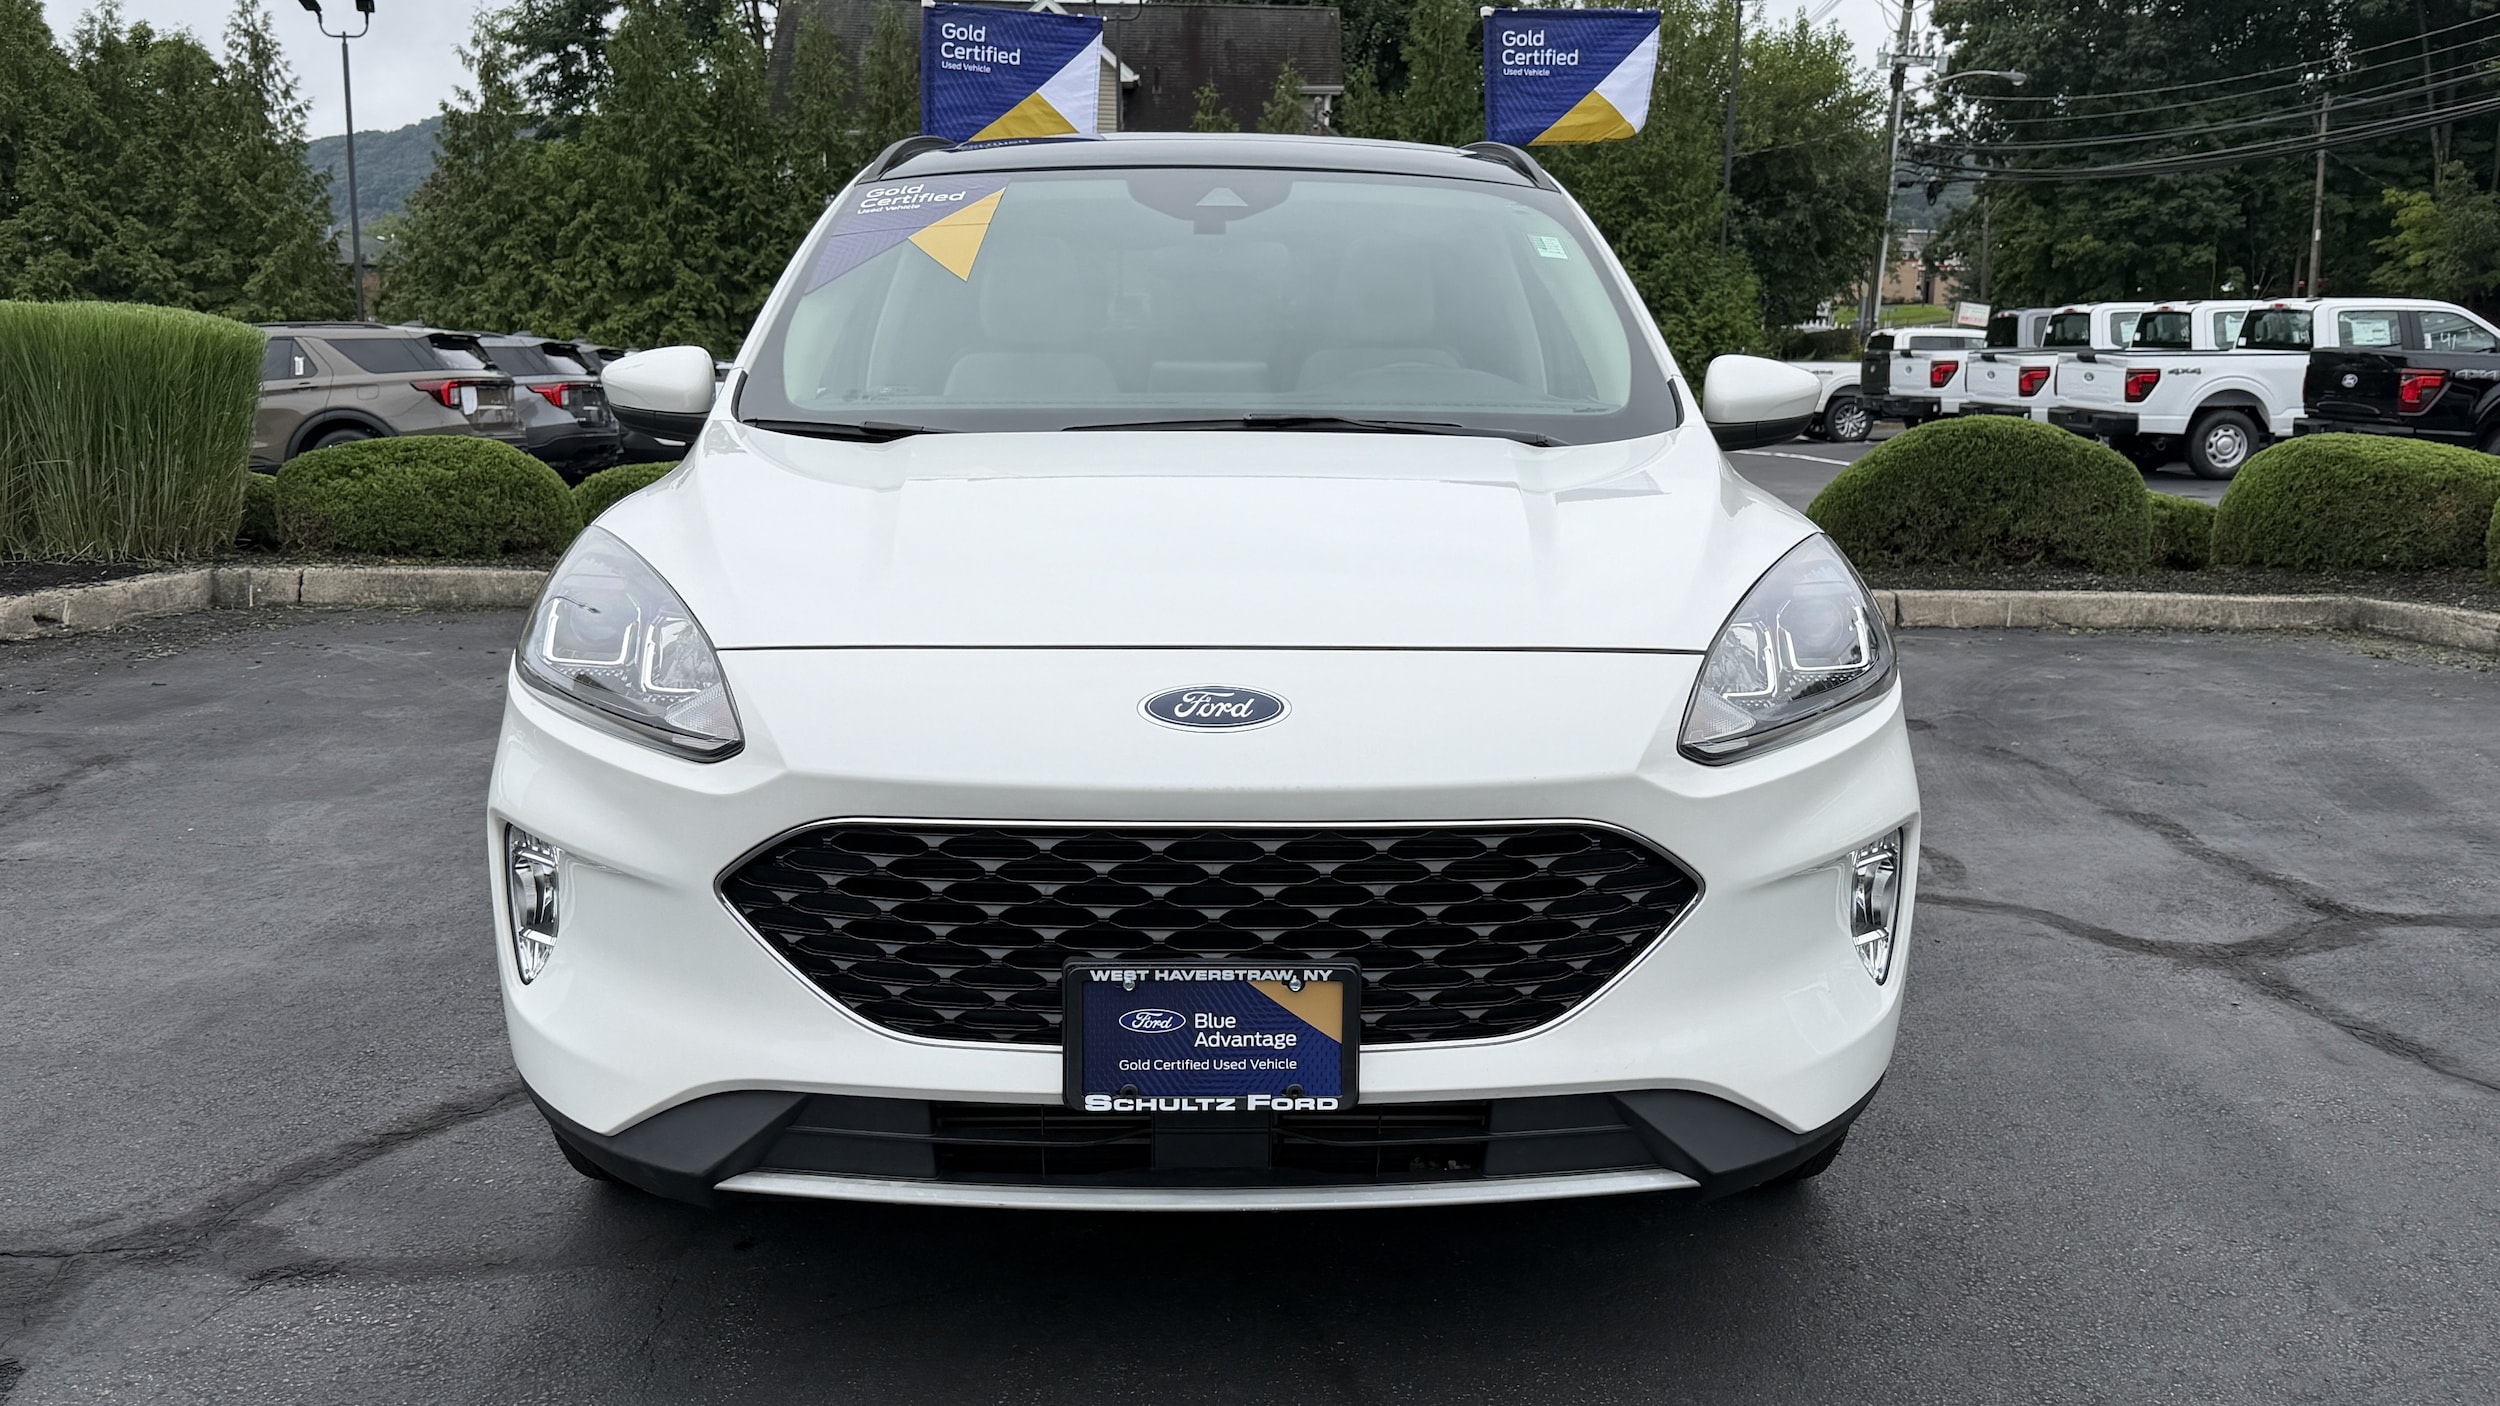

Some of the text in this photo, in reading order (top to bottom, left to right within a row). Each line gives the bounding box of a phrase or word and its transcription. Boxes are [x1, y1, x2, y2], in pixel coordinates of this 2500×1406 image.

[942, 23, 986, 42] Gold
[1502, 30, 1545, 47] Gold
[941, 42, 1021, 65] Certified
[1501, 48, 1579, 66] Certified
[941, 61, 991, 74] Used Vehicle
[1503, 68, 1550, 77] Used Vehicle
[866, 184, 925, 198] Gold
[860, 191, 967, 208] Certified
[857, 204, 921, 215] Used Vehicle
[1174, 691, 1255, 718] Ford
[1090, 970, 1149, 981] WEST
[1303, 970, 1333, 981] NY
[1131, 1012, 1173, 1030] Ford
[1195, 1013, 1236, 1029] Blue
[1194, 1032, 1297, 1049] Advantage
[1119, 1058, 1297, 1071] Gold Certified Used Vehicle
[1085, 1095, 1339, 1111] SCHULTZ FORD
